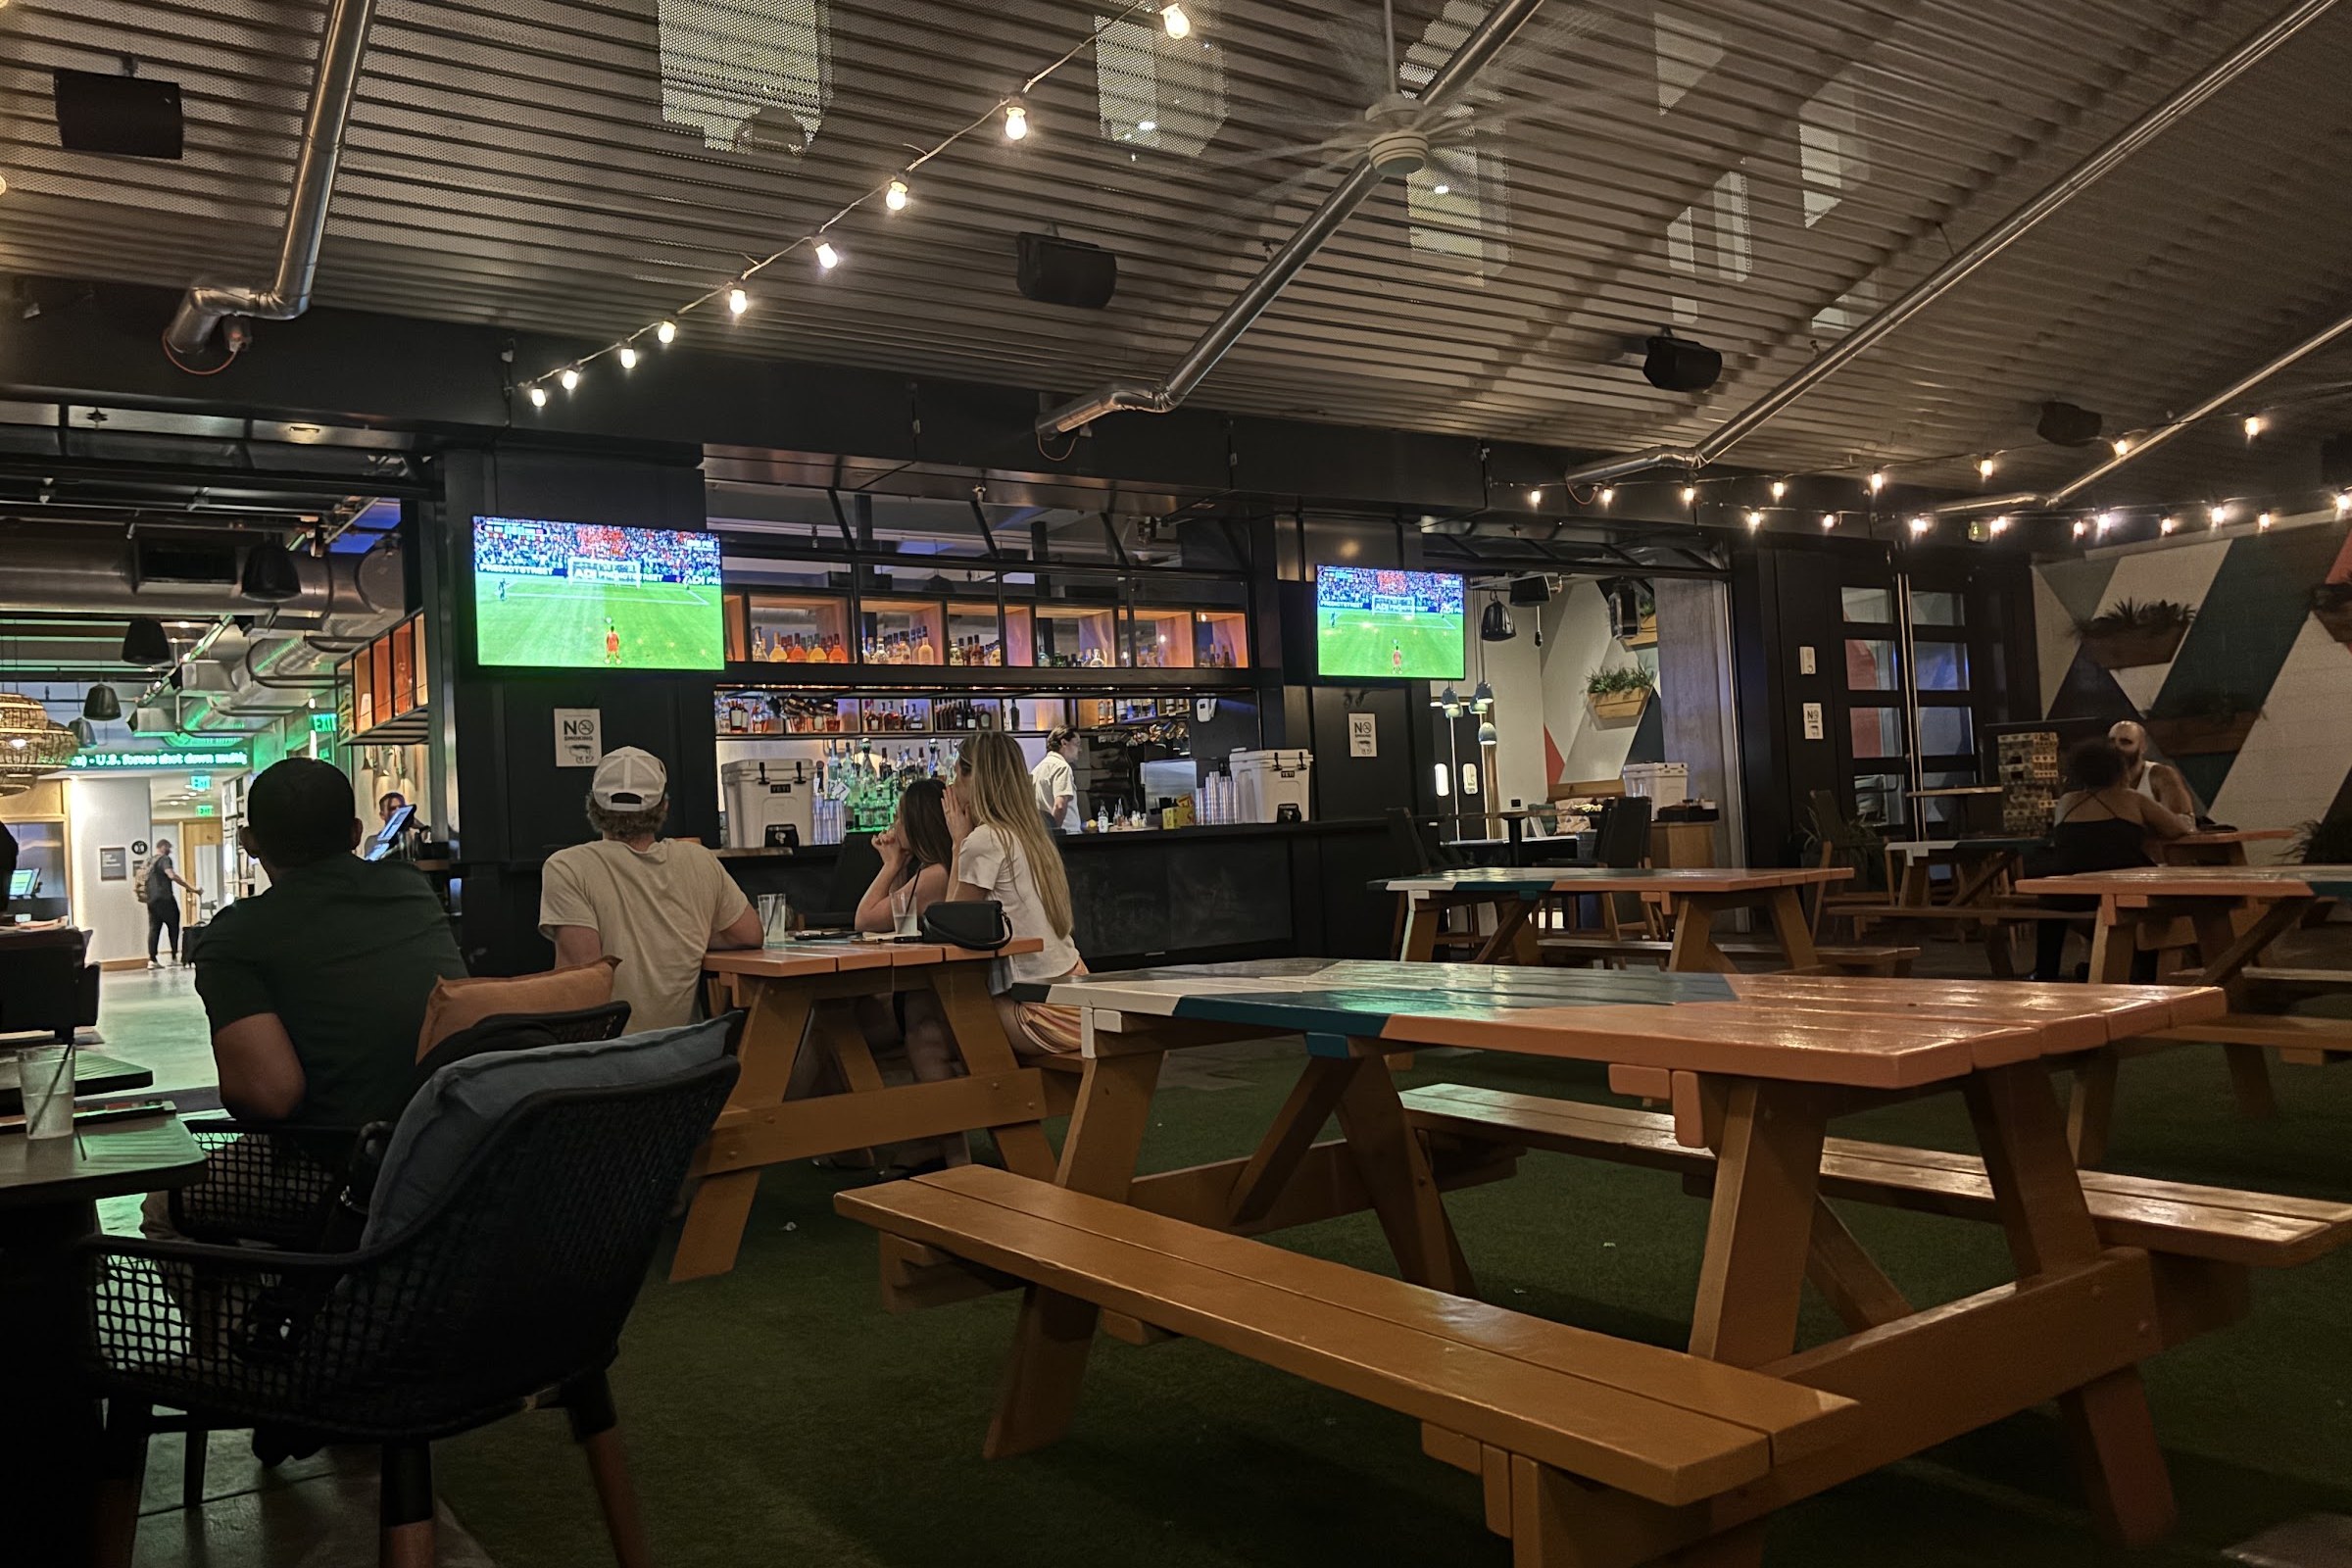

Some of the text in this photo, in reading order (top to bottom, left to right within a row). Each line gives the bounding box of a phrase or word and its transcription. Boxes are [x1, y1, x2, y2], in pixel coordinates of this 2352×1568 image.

[315, 713, 337, 732] EXIT
[95, 754, 122, 765] U.S.
[122, 754, 158, 765] forces
[159, 753, 183, 765] shot
[184, 752, 214, 765] down
